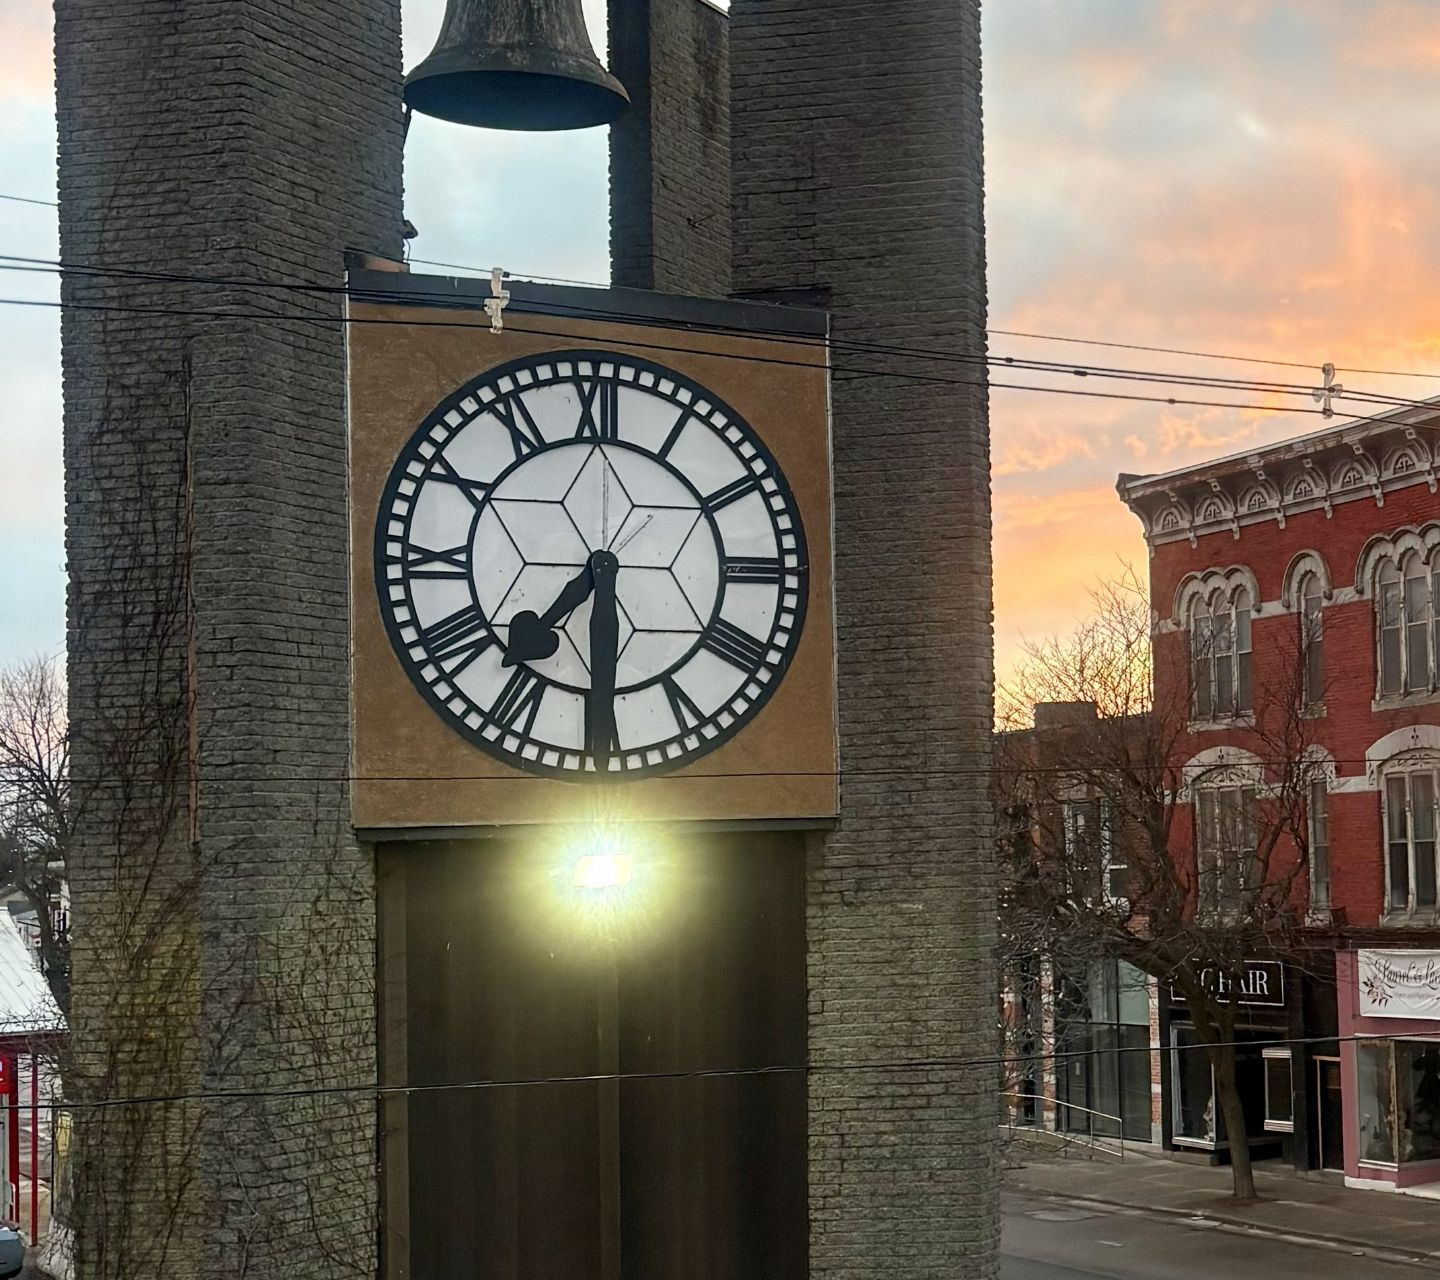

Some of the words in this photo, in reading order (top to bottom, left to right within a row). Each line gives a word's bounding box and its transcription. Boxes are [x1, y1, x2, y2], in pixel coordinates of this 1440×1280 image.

[488, 392, 546, 457] XI
[574, 380, 618, 440] XII
[656, 408, 692, 459] I
[424, 455, 492, 510] X
[703, 472, 760, 516] II
[406, 542, 468, 581] IX
[724, 556, 780, 584] III
[424, 606, 496, 676] VIII
[488, 664, 548, 739] VII
[661, 677, 707, 736] V
